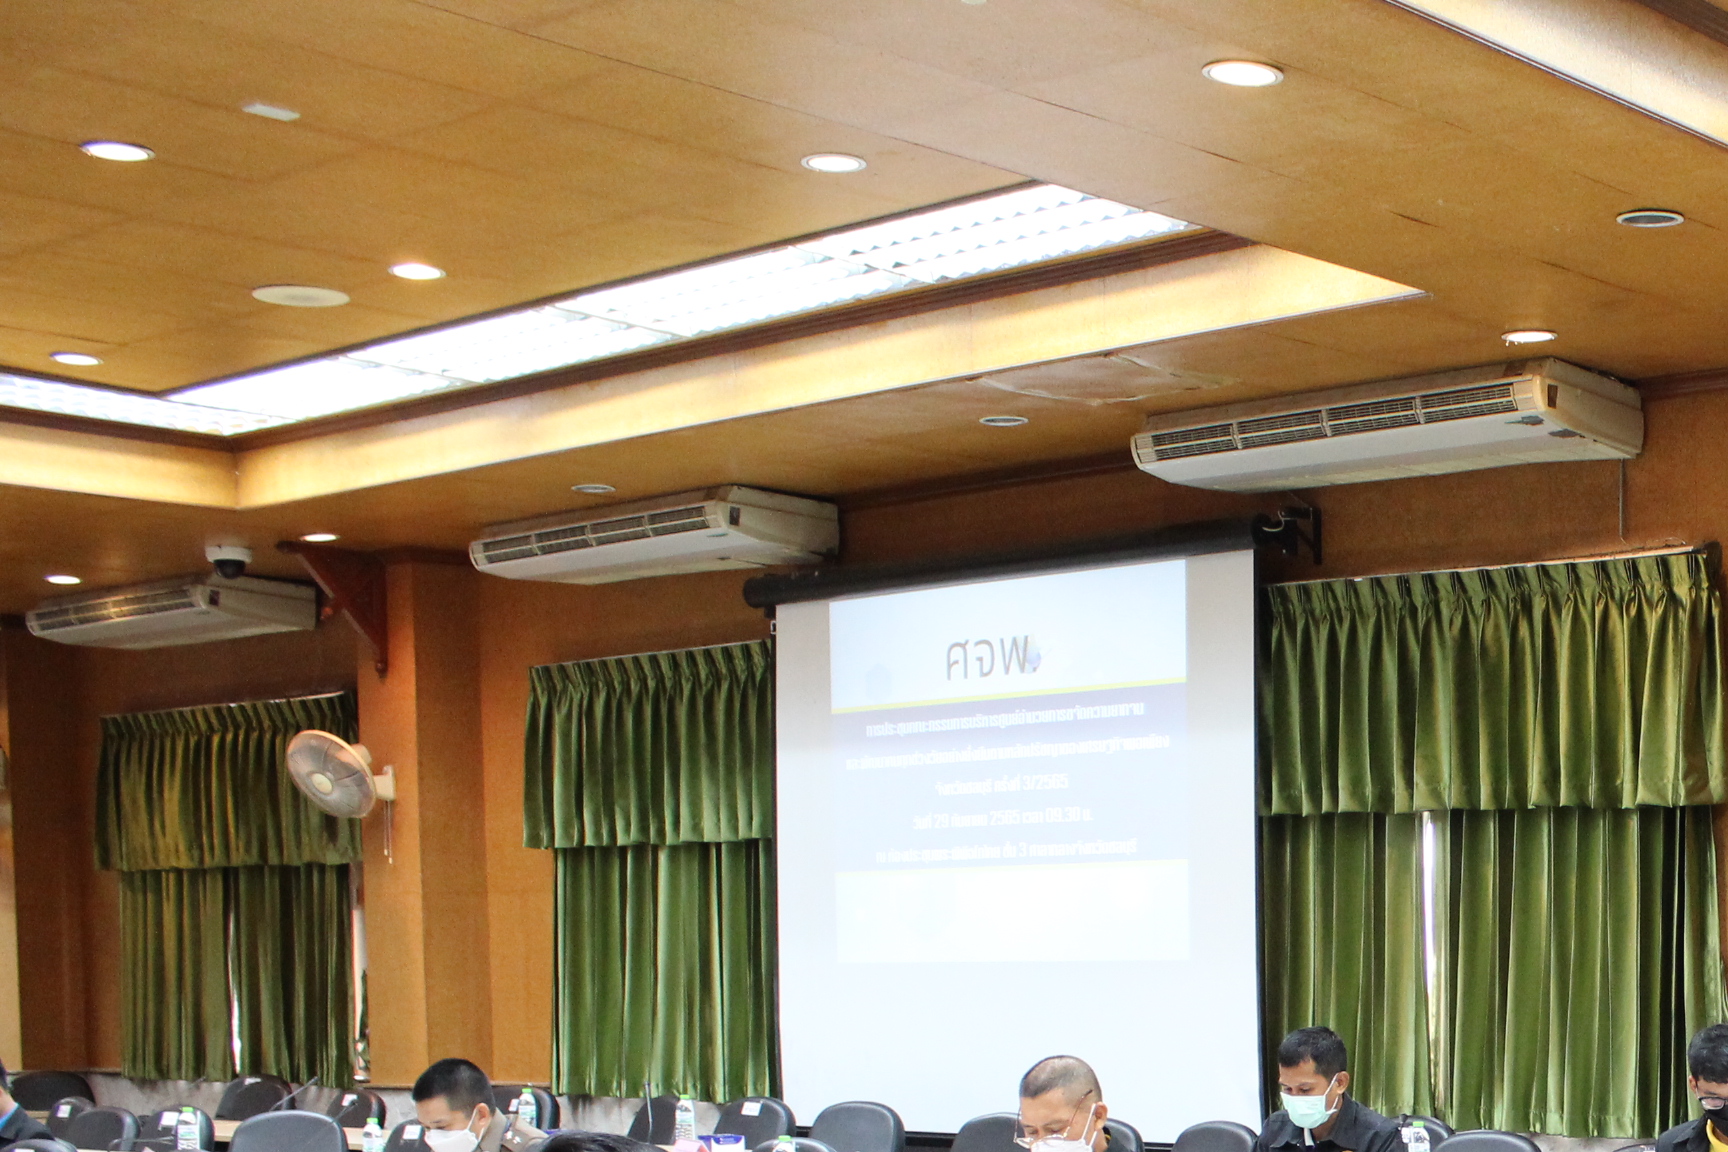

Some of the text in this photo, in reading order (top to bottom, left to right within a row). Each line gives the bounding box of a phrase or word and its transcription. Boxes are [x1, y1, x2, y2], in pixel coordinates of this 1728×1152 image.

[1022, 773, 1069, 791] 3/2565
[933, 813, 949, 829] 29
[989, 808, 1020, 826] 2565
[1045, 806, 1080, 823] 09.30
[1018, 841, 1027, 857] 3
